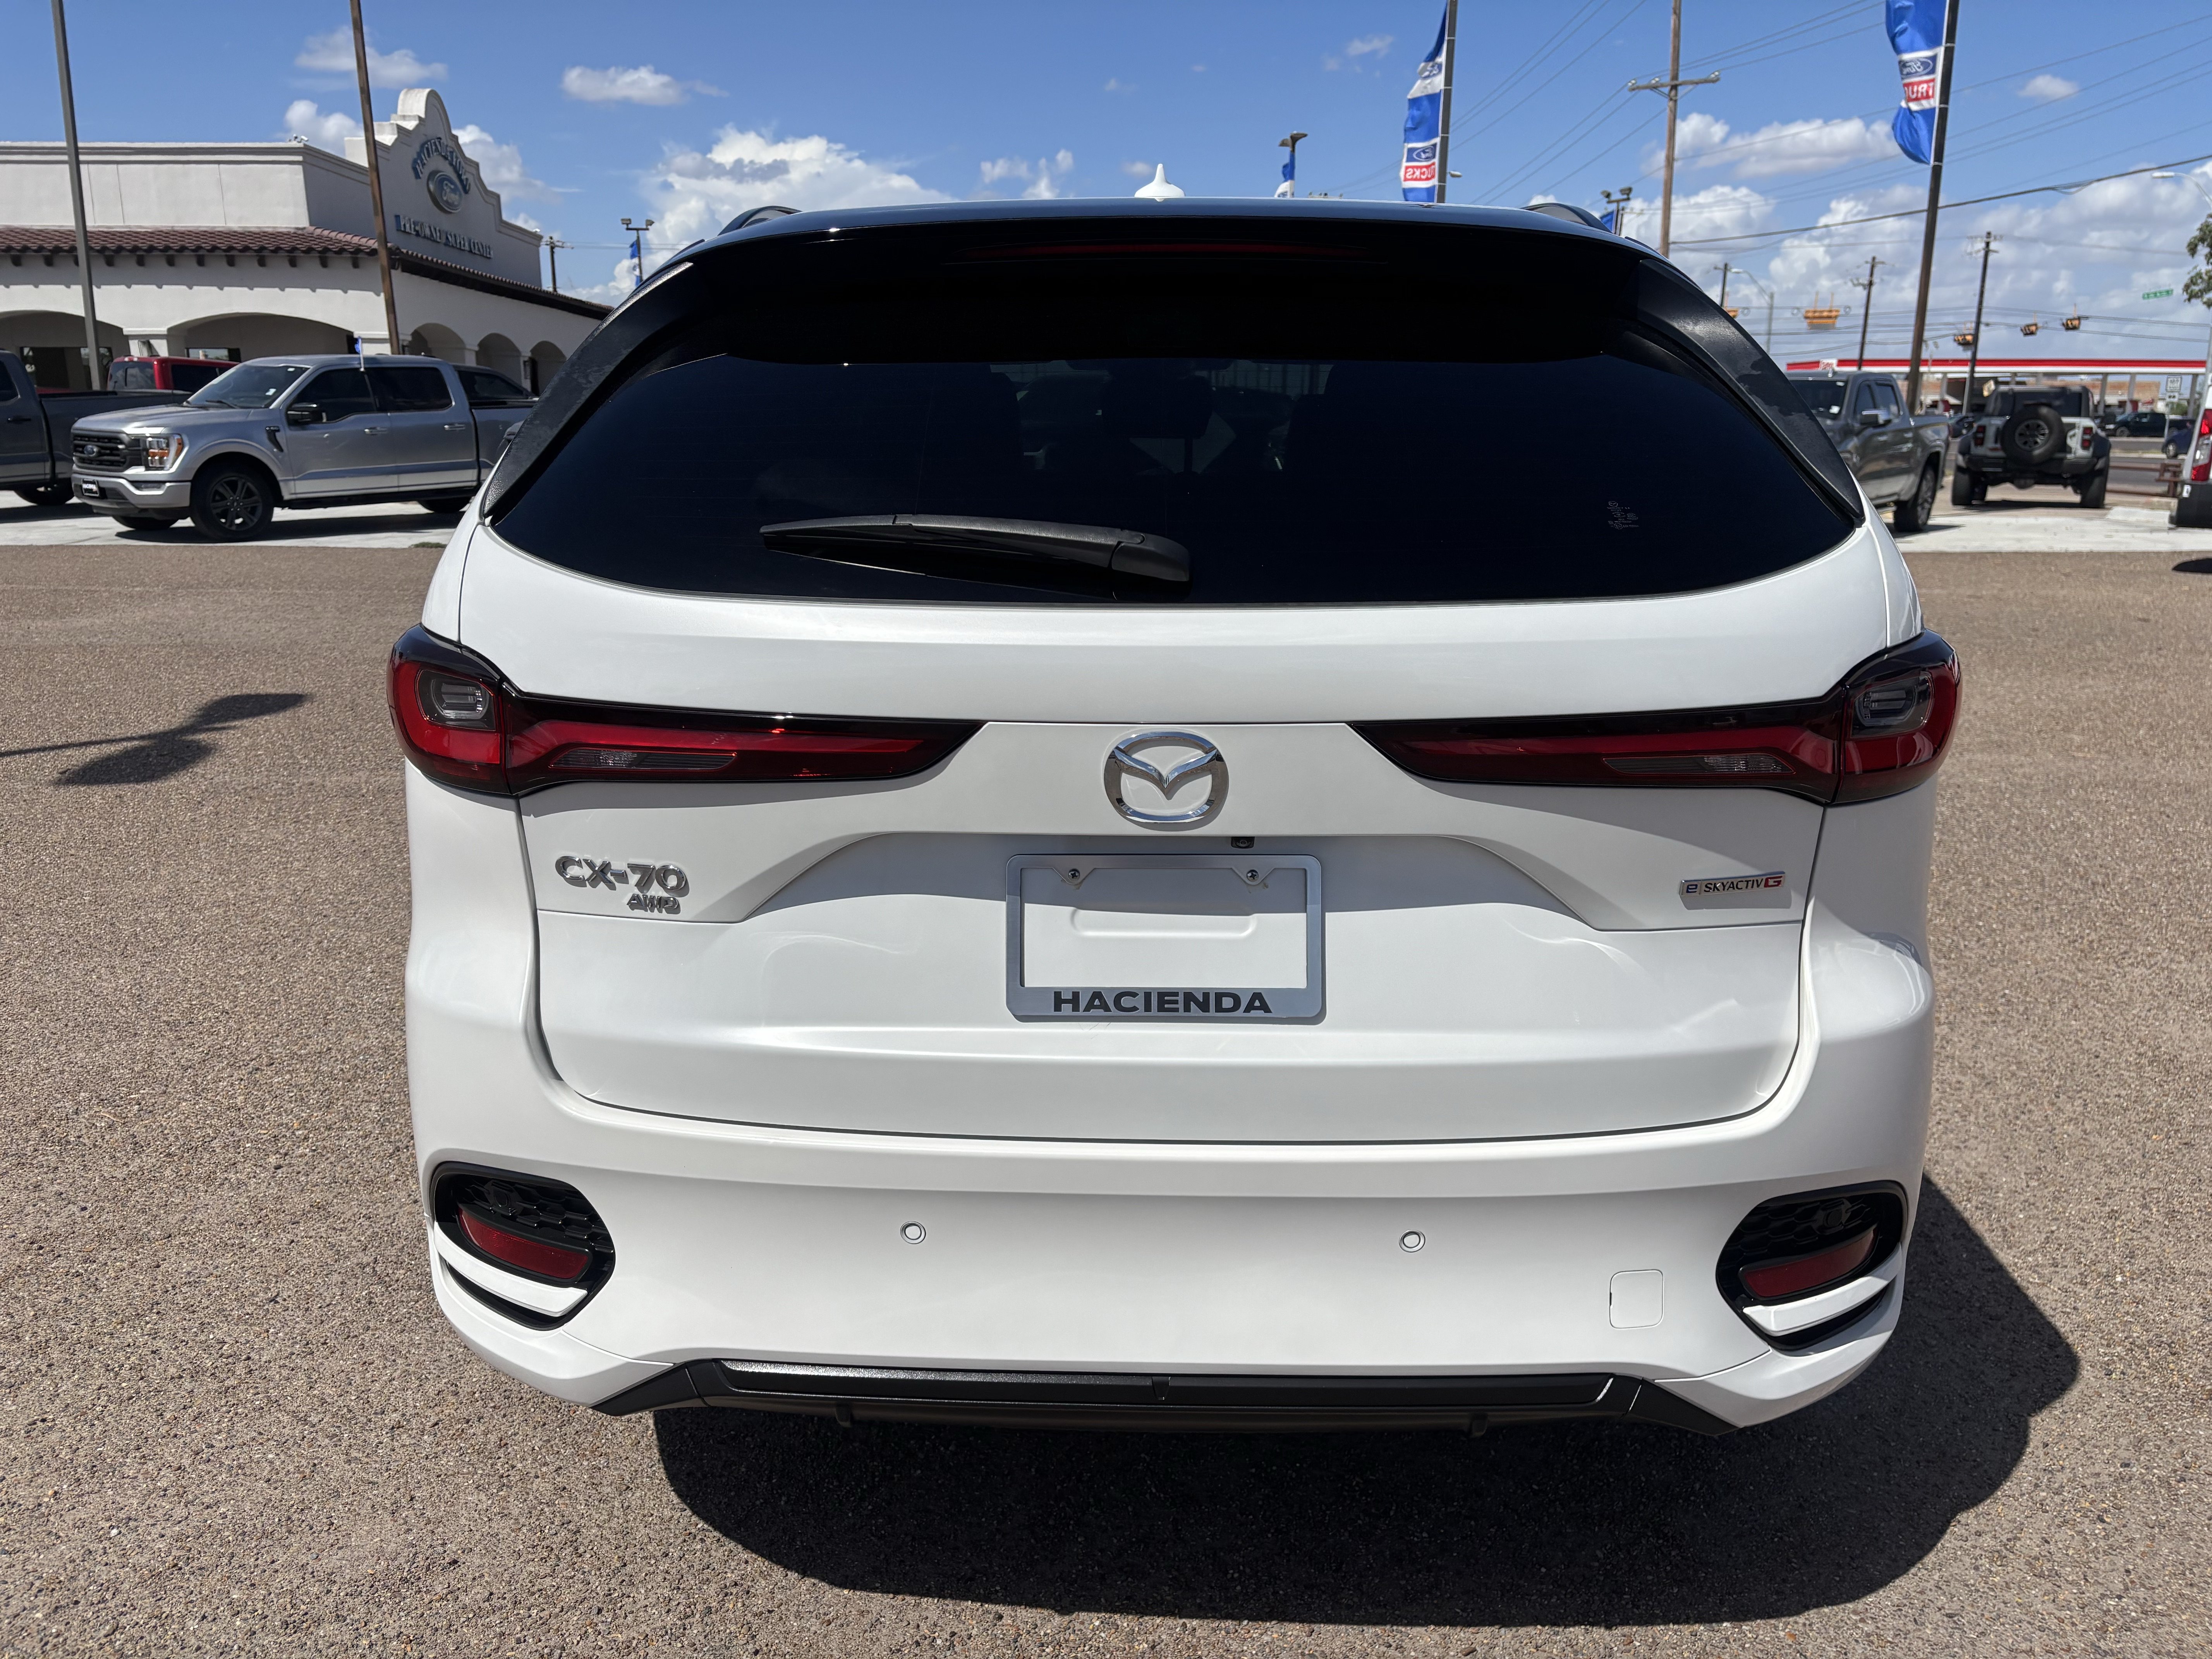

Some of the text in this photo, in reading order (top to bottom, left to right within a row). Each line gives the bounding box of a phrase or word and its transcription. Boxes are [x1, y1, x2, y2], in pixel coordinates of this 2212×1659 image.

[555, 856, 686, 891] CX-70
[1704, 878, 1764, 893] SKYACTIV
[626, 893, 678, 910] AWD
[1053, 991, 1273, 1014] HACIENDA
